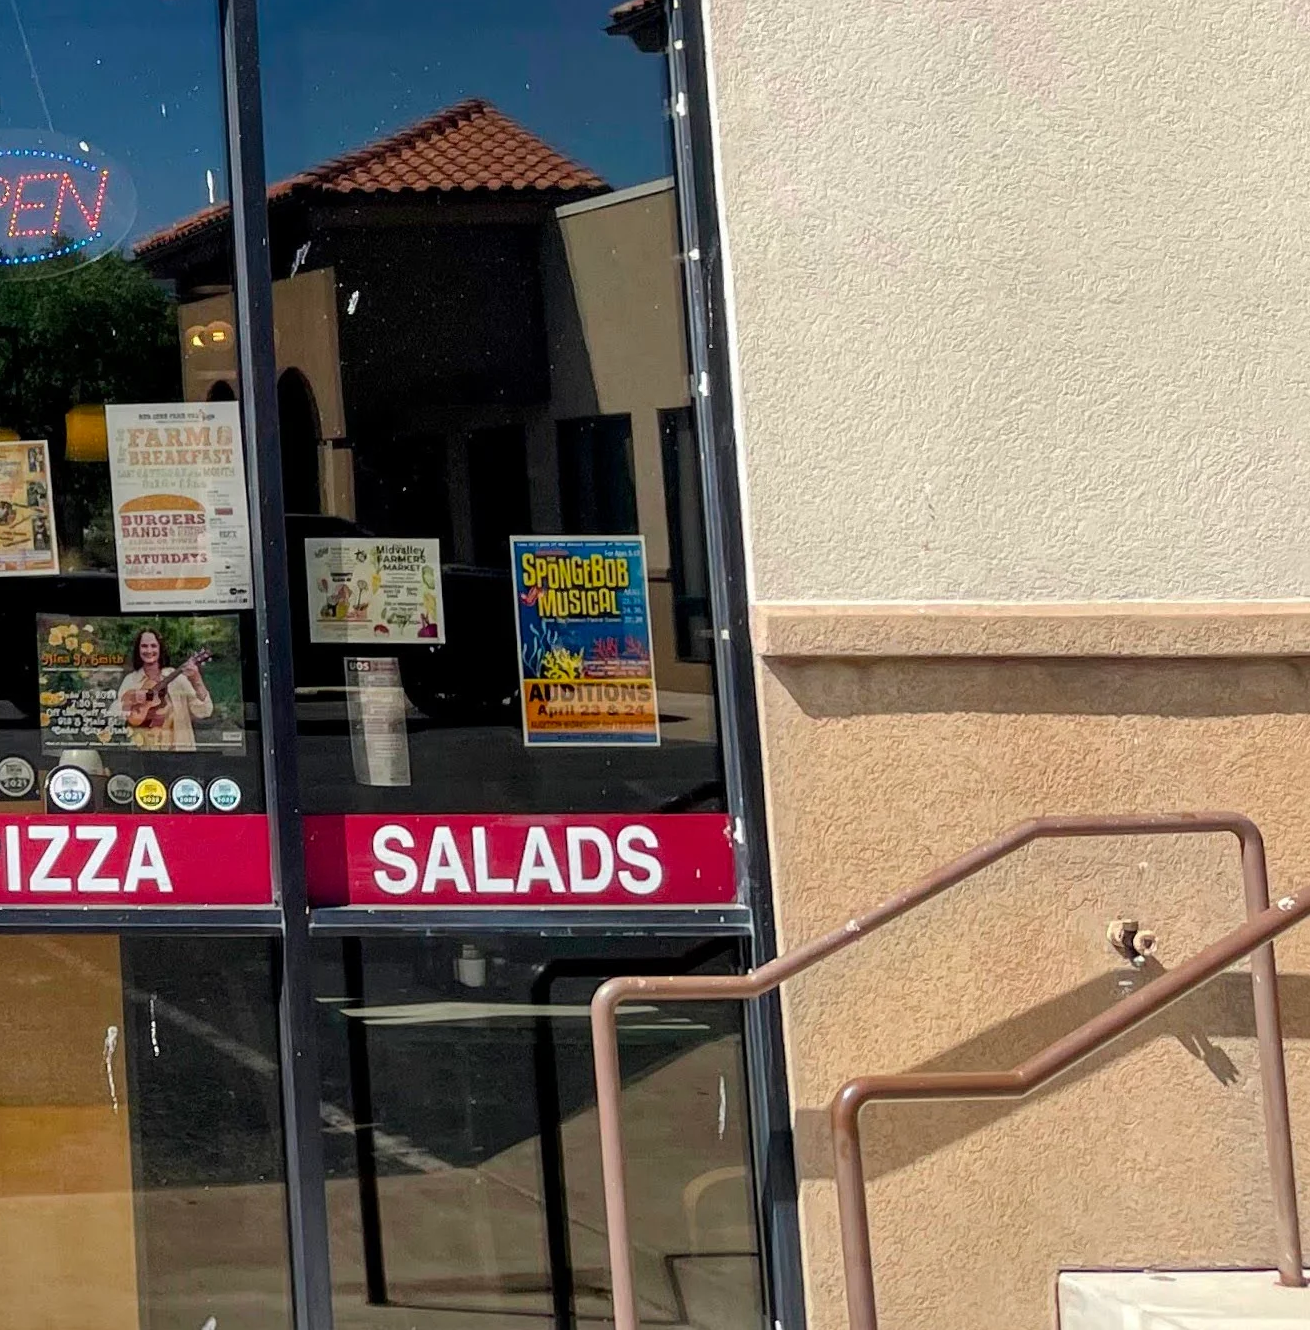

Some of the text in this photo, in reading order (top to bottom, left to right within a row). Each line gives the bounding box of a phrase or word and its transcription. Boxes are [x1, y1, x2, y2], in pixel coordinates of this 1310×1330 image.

[127, 427, 212, 448] FARM
[128, 449, 233, 466] BREAKFAST
[121, 514, 206, 526] BURGERS
[122, 527, 168, 538] BANDS
[125, 553, 208, 565] SATURDAYS
[377, 555, 427, 564] FARMERS
[529, 683, 653, 703] AUDITIONS
[537, 704, 575, 717] April
[4, 778, 27, 788] 2021
[59, 792, 83, 800] 2021
[371, 824, 663, 895] SALADS
